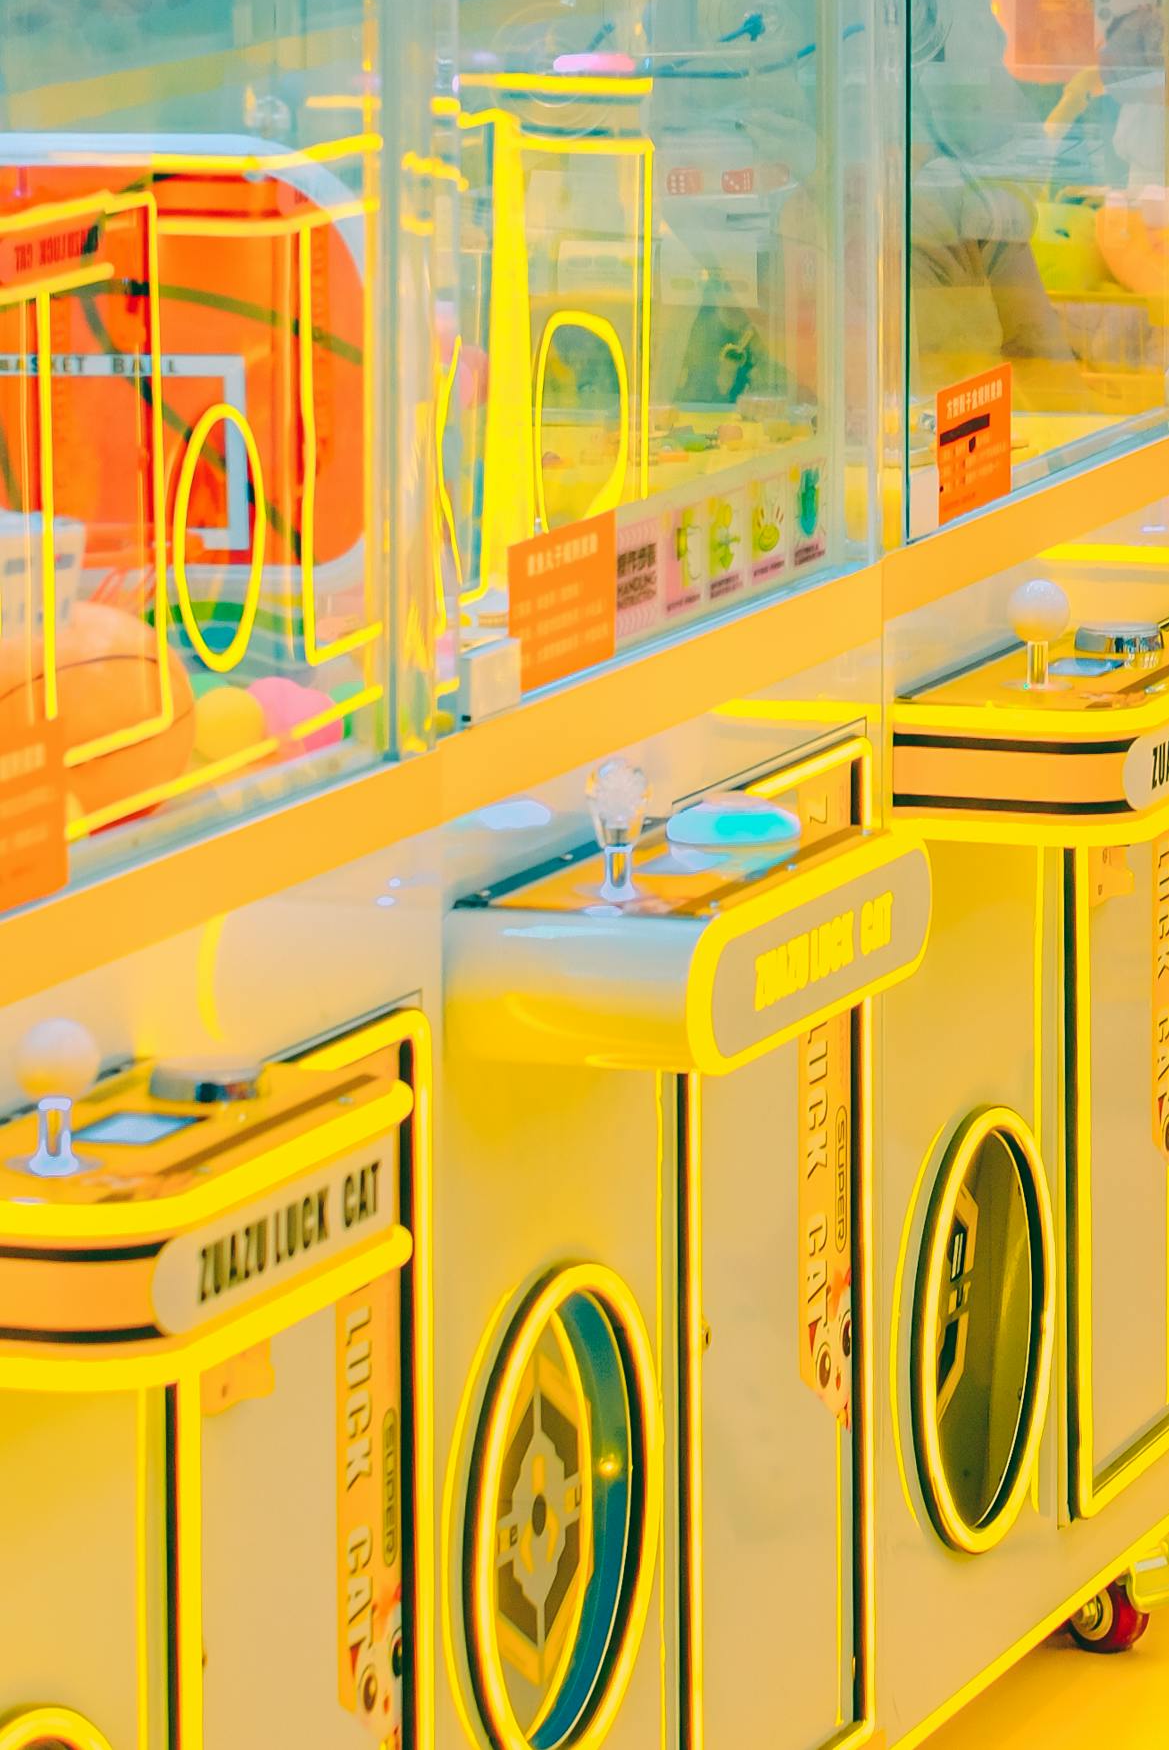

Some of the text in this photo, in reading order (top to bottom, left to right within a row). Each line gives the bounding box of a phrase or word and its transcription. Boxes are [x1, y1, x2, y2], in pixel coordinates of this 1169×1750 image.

[112, 356, 177, 373] BAL
[198, 1159, 382, 1305] ZUAZU LUCK CAT
[346, 1304, 374, 1492] LUCK
